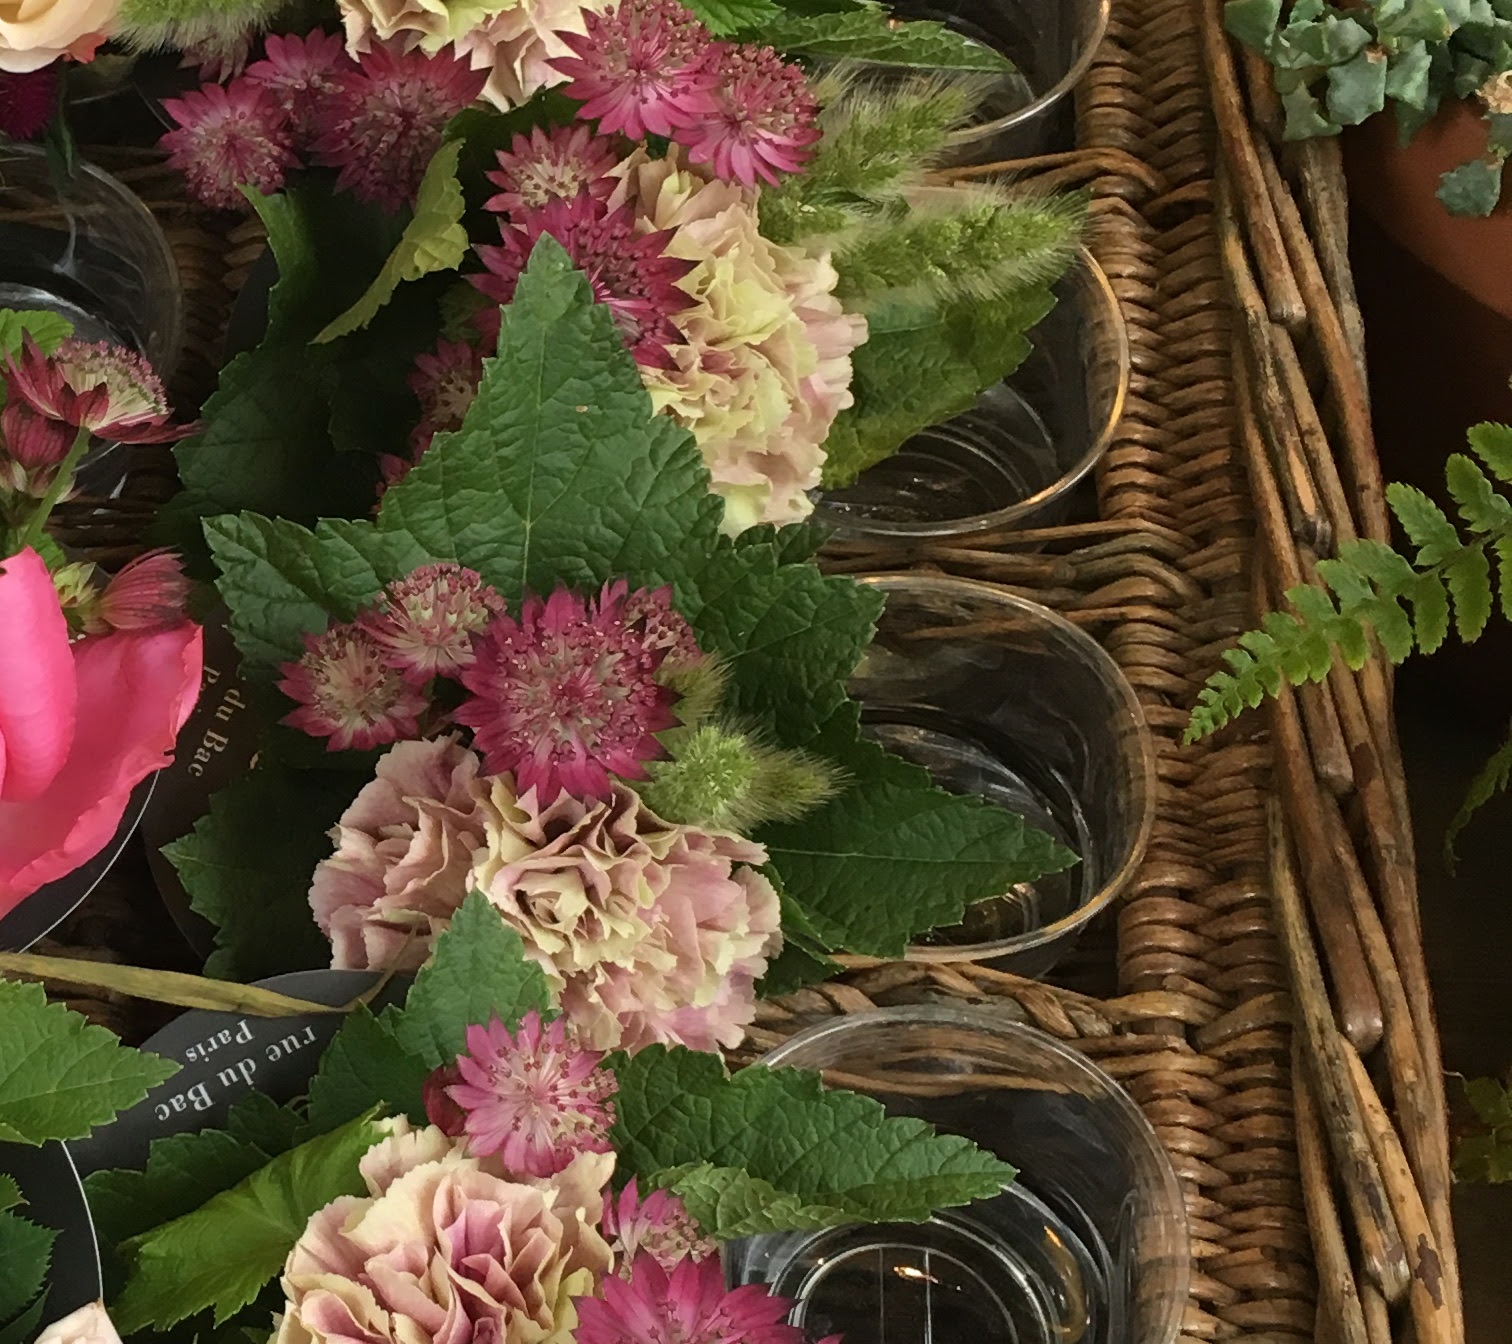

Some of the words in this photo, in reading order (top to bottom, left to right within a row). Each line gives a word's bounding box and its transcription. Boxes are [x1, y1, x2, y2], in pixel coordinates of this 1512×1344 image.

[215, 688, 246, 722] du
[188, 728, 229, 777] Bac
[185, 1019, 255, 1062] Paris
[265, 1025, 317, 1062] rue
[216, 1058, 257, 1087] du
[154, 1081, 216, 1121] Bac
